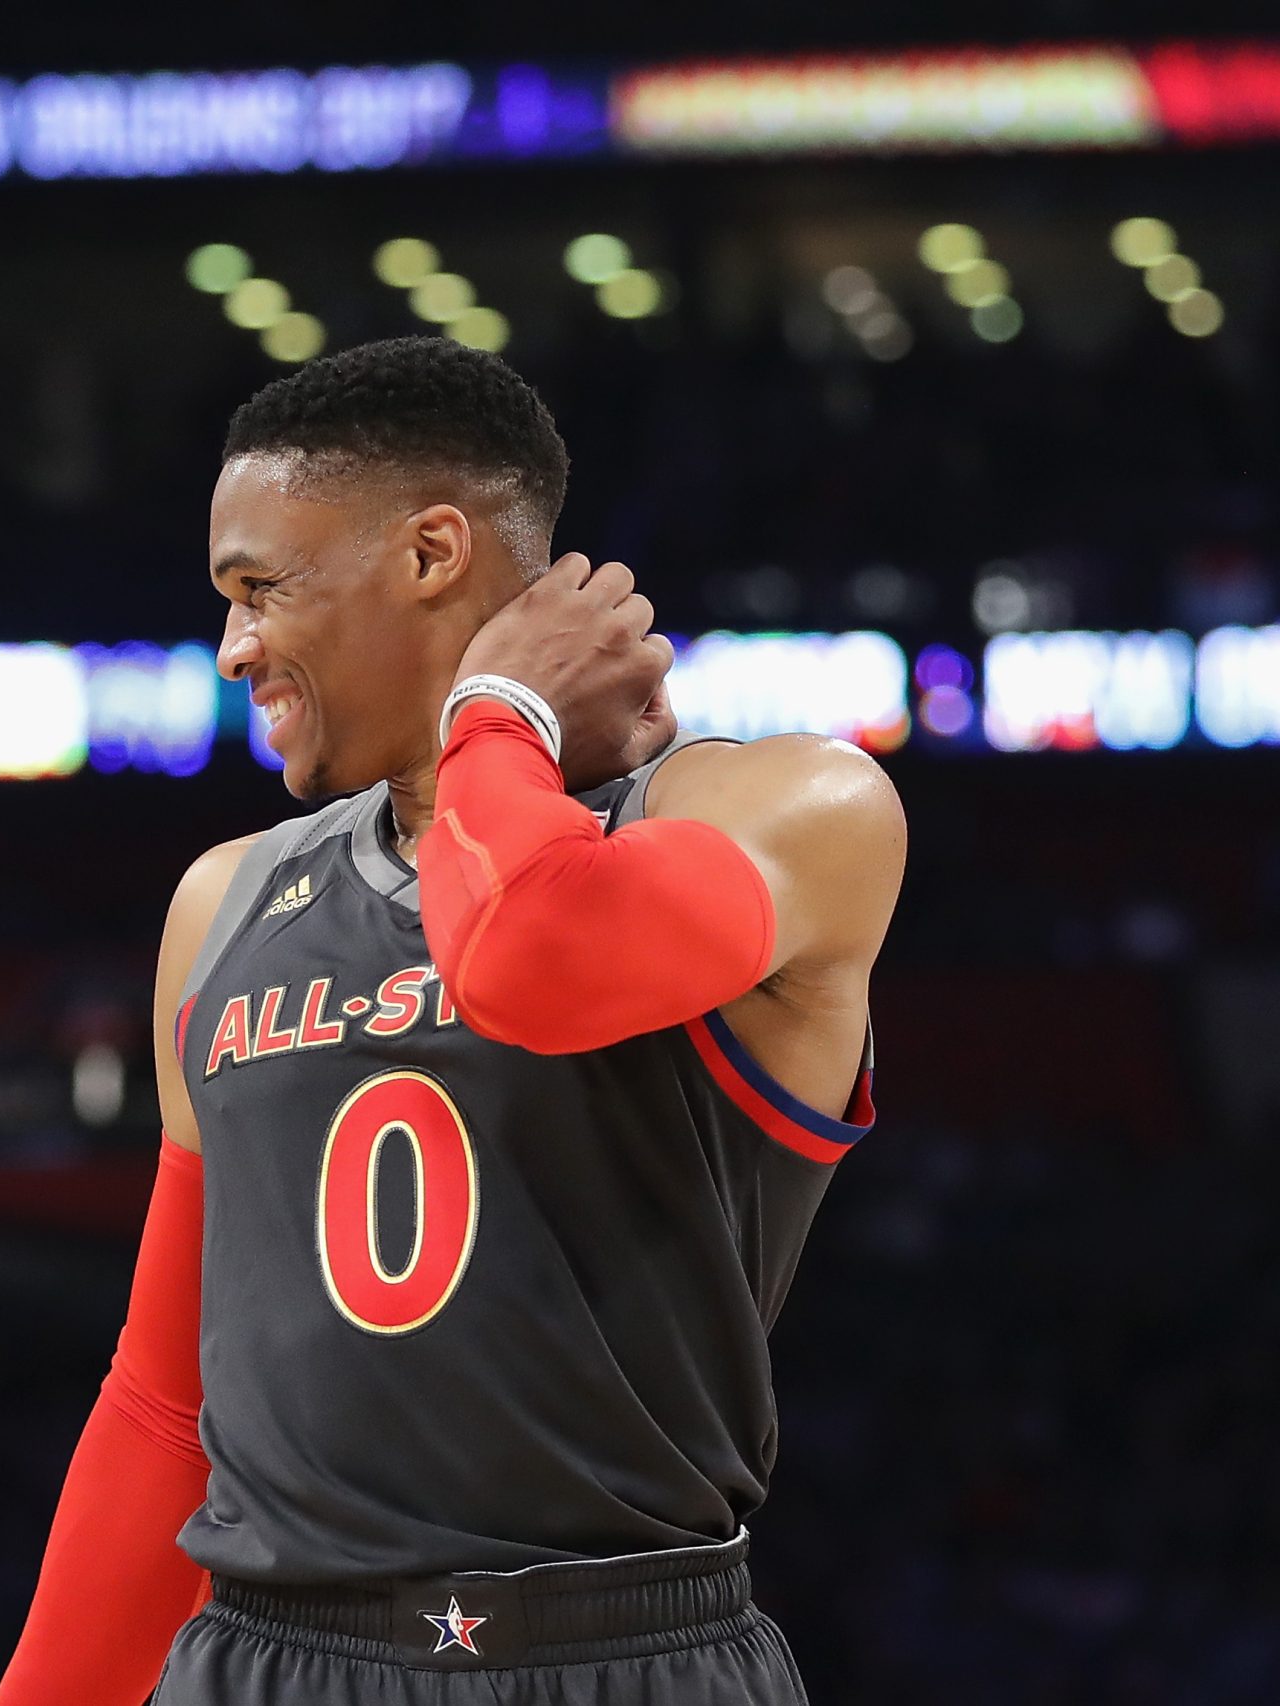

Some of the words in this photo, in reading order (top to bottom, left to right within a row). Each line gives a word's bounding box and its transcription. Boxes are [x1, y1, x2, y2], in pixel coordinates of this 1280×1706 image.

[452, 684, 481, 699] RIP
[262, 895, 314, 920] adidas
[317, 1068, 479, 1336] 0
